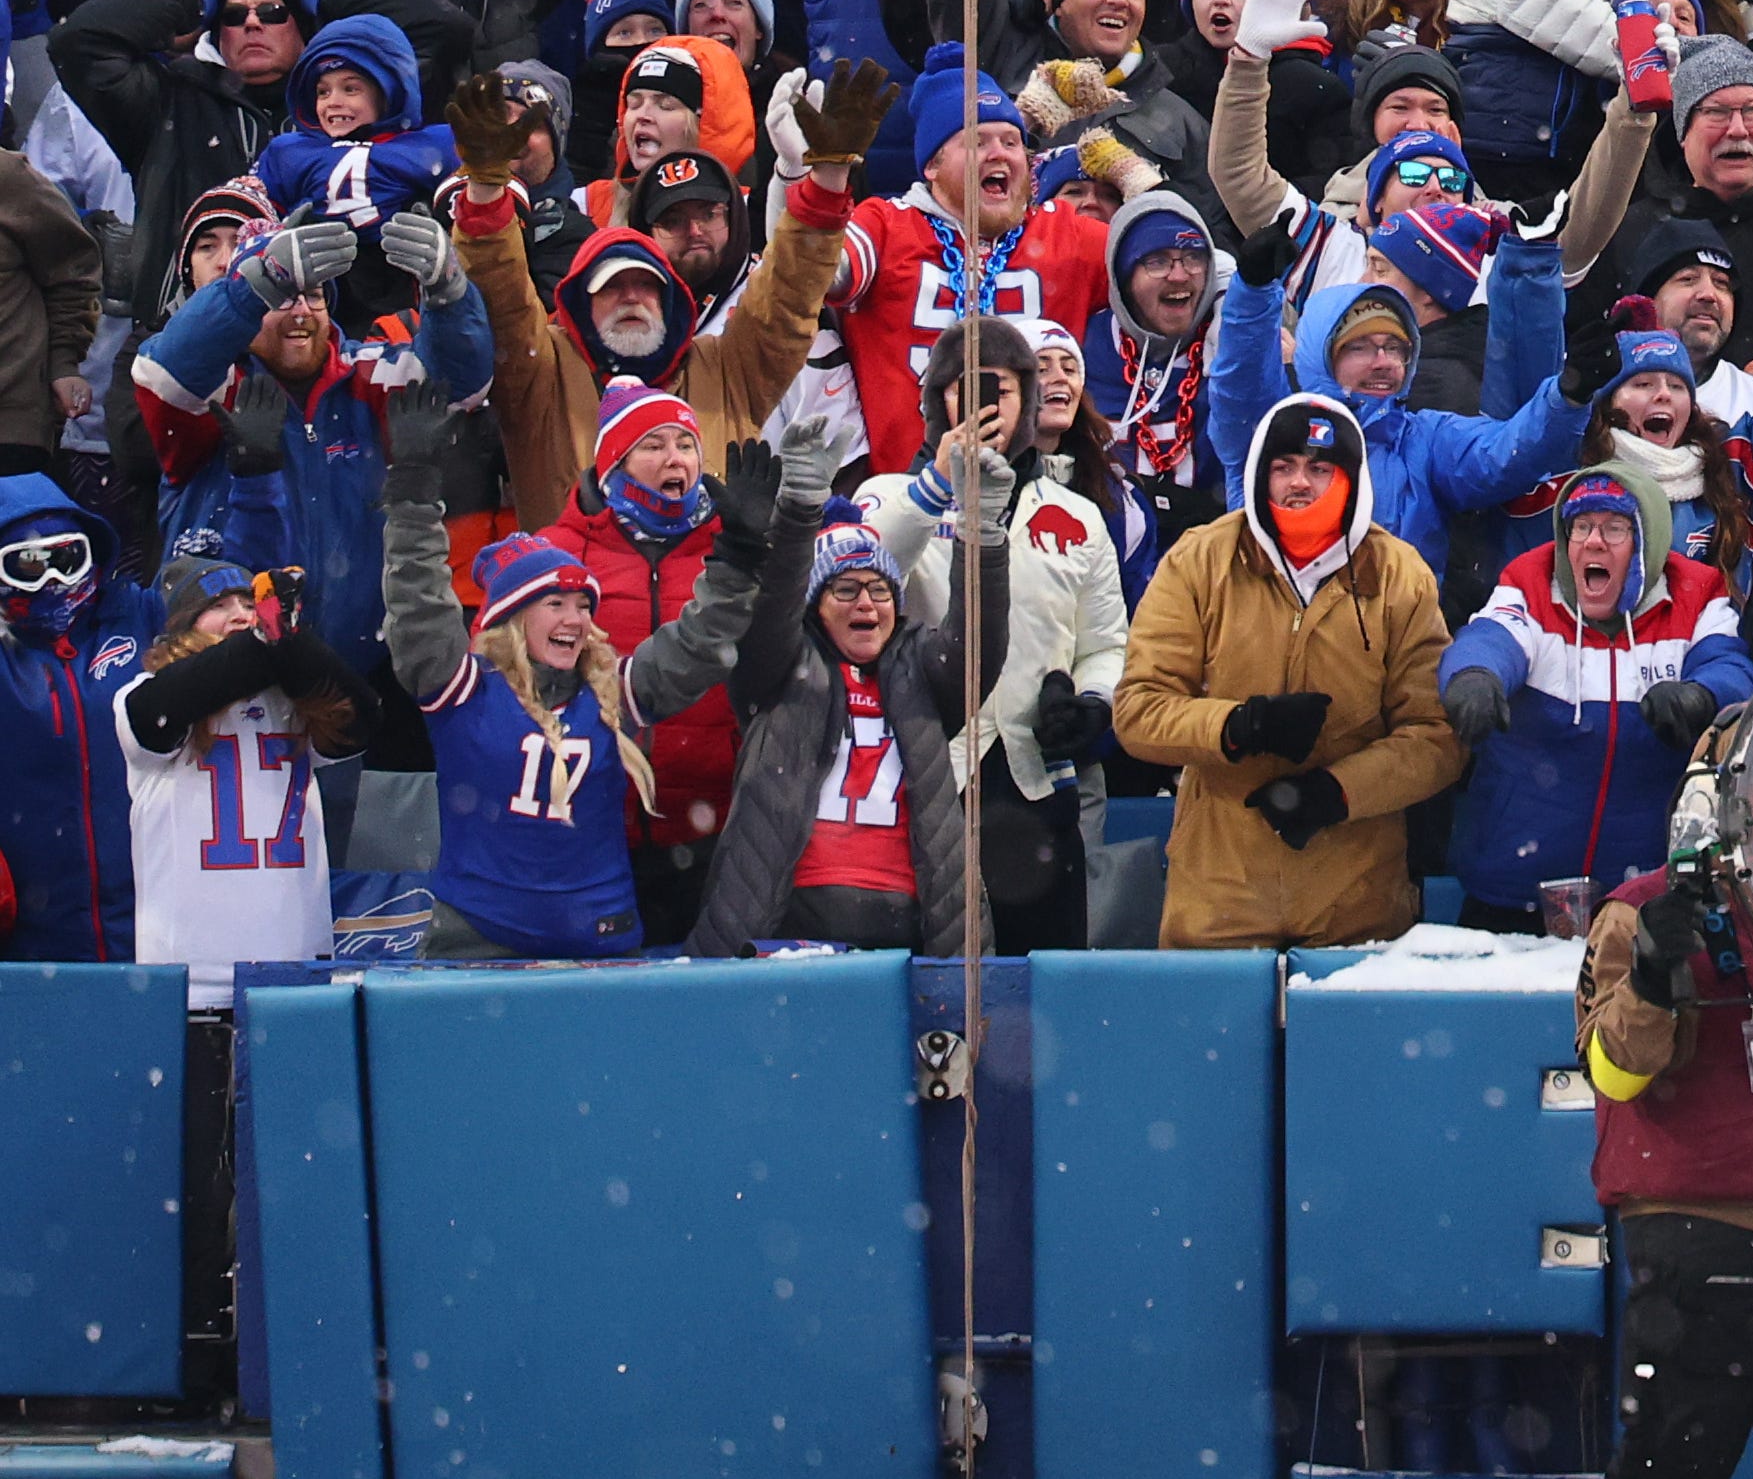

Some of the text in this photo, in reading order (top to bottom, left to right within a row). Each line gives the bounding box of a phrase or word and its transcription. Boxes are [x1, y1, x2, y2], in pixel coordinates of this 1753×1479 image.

[326, 146, 378, 227] 4
[198, 731, 314, 872] 17
[508, 731, 592, 825] 17
